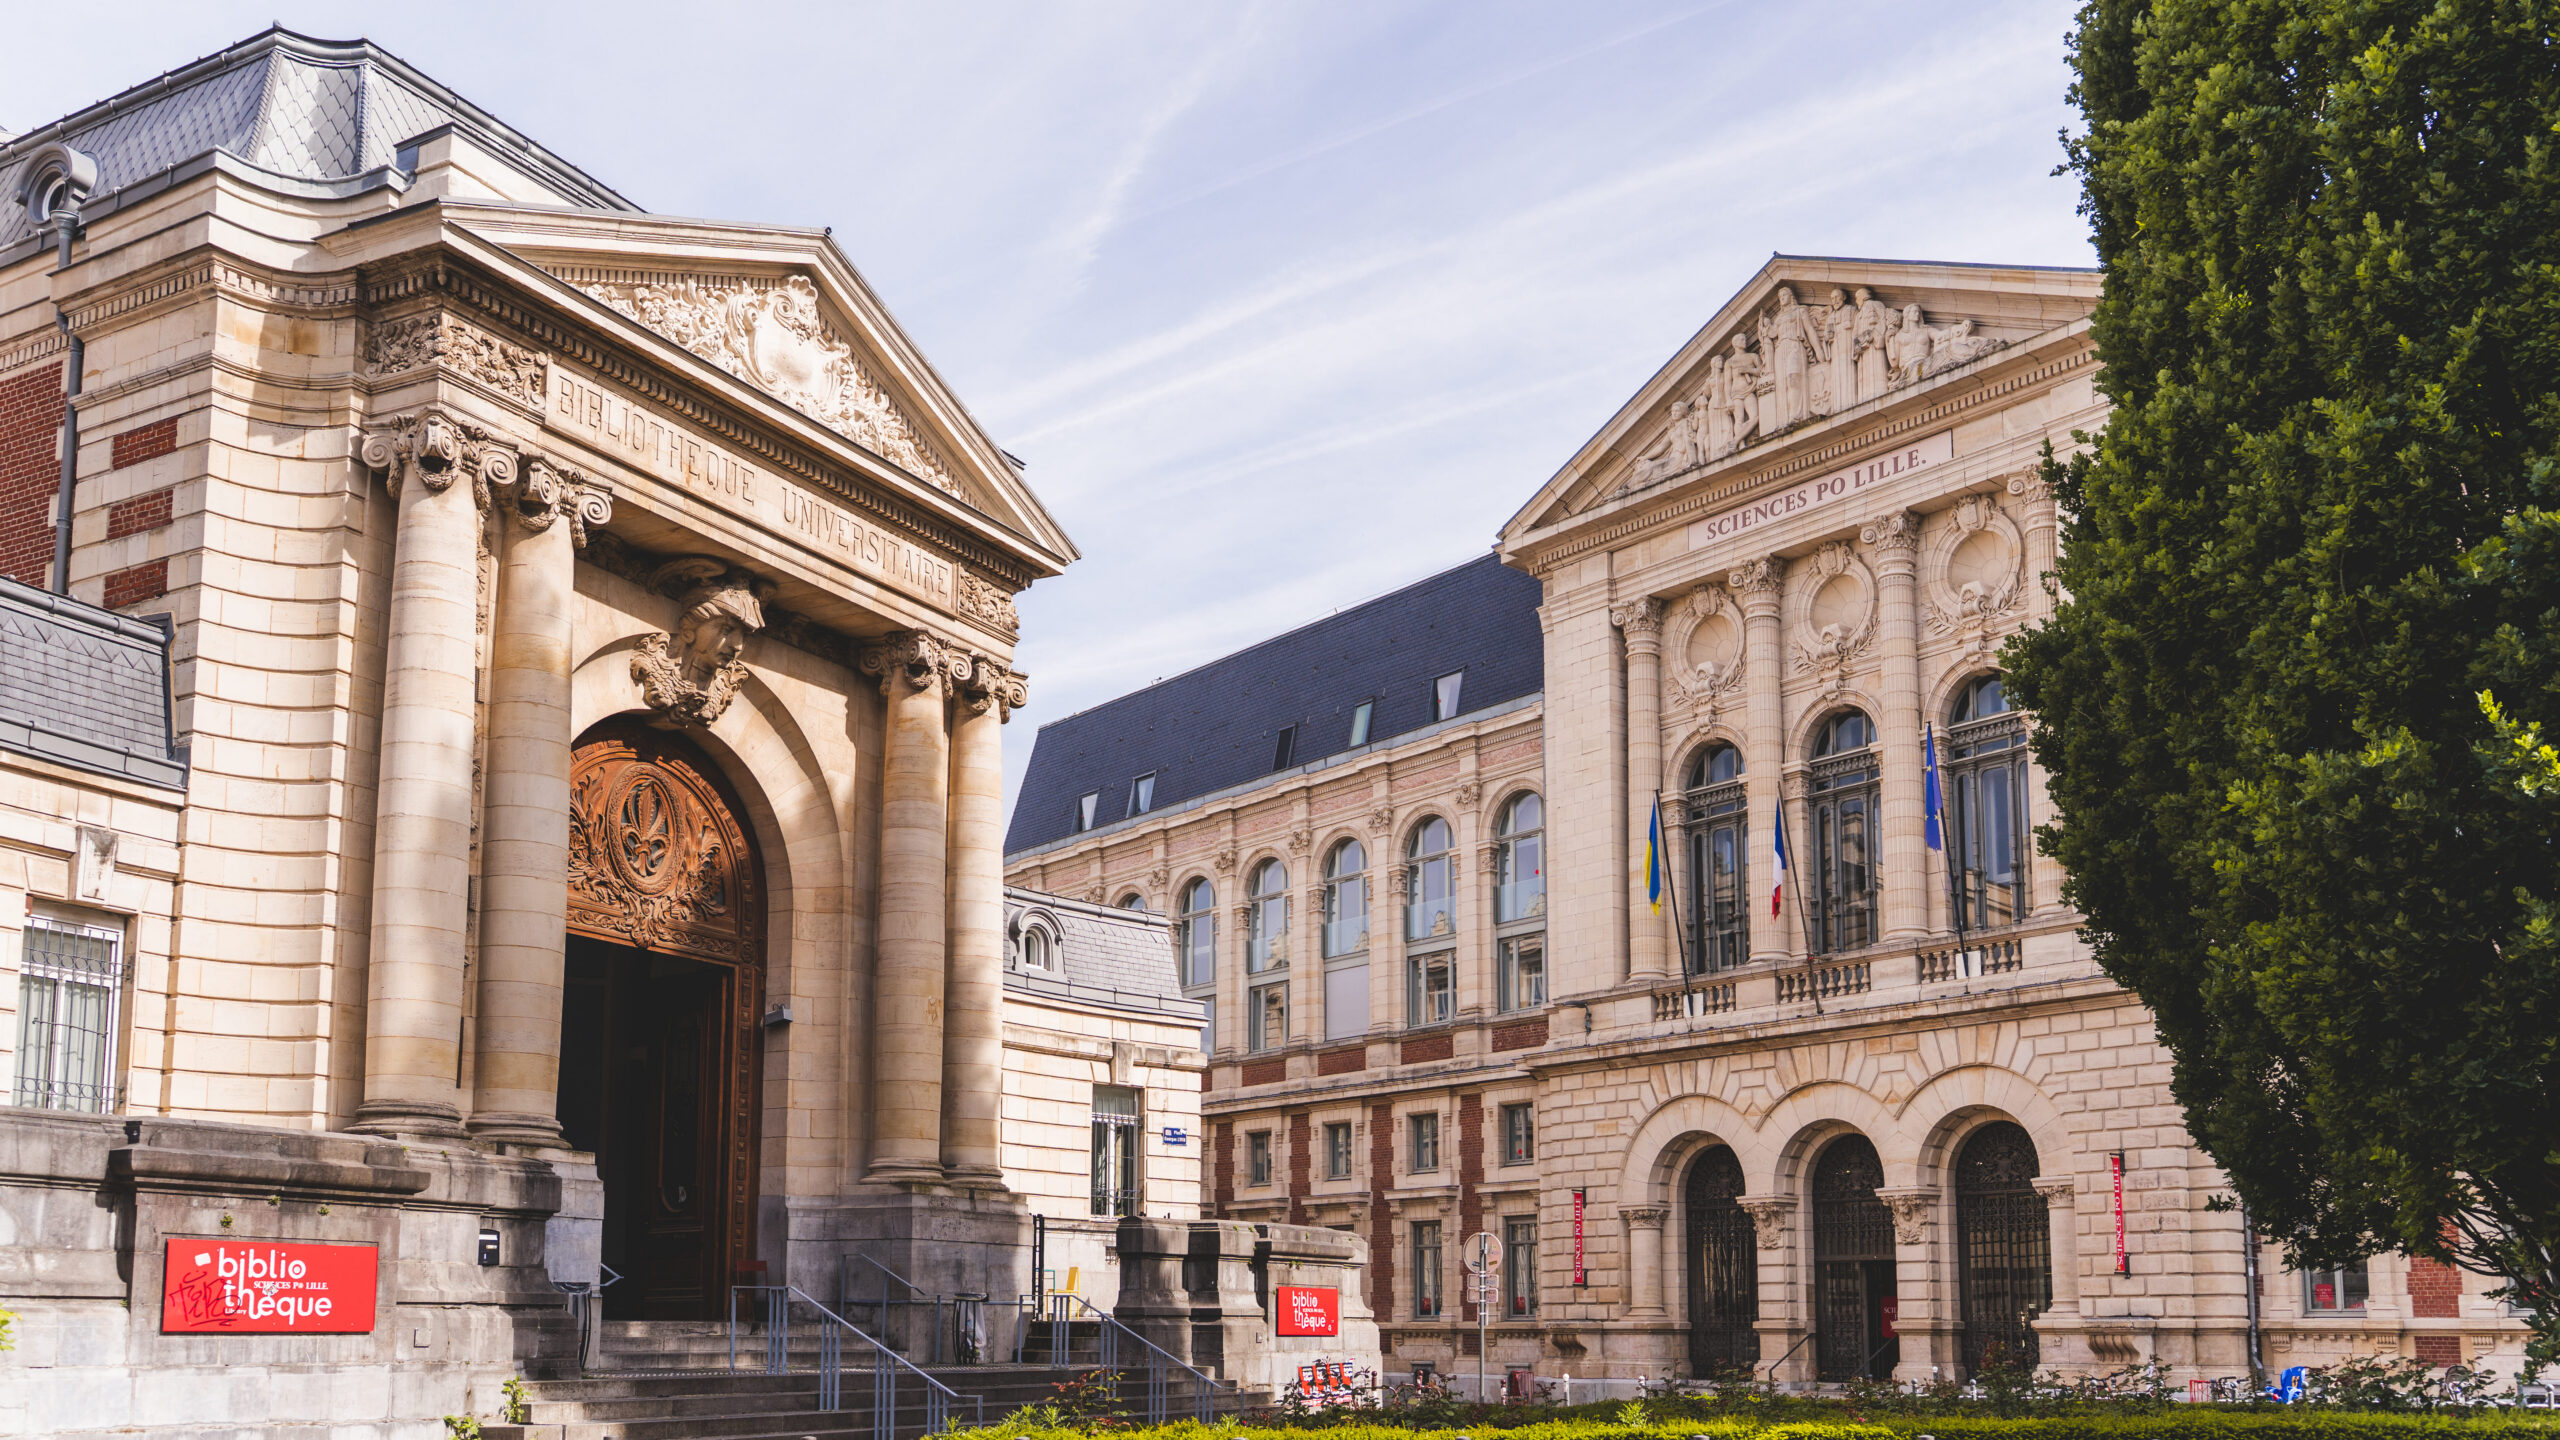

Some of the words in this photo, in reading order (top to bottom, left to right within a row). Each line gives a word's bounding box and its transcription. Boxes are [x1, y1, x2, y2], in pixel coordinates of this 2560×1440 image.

[559, 374, 755, 505] BIBLIOTHEQUE
[781, 485, 950, 599] UNIVERSITAIRE
[1707, 489, 1807, 540] SCIENCES
[1816, 477, 1846, 502] PO
[1854, 448, 1927, 488] LILLE.
[218, 1247, 306, 1279] biblio
[1292, 1290, 1318, 1307] biblio
[1294, 1307, 1326, 1332] thèque
